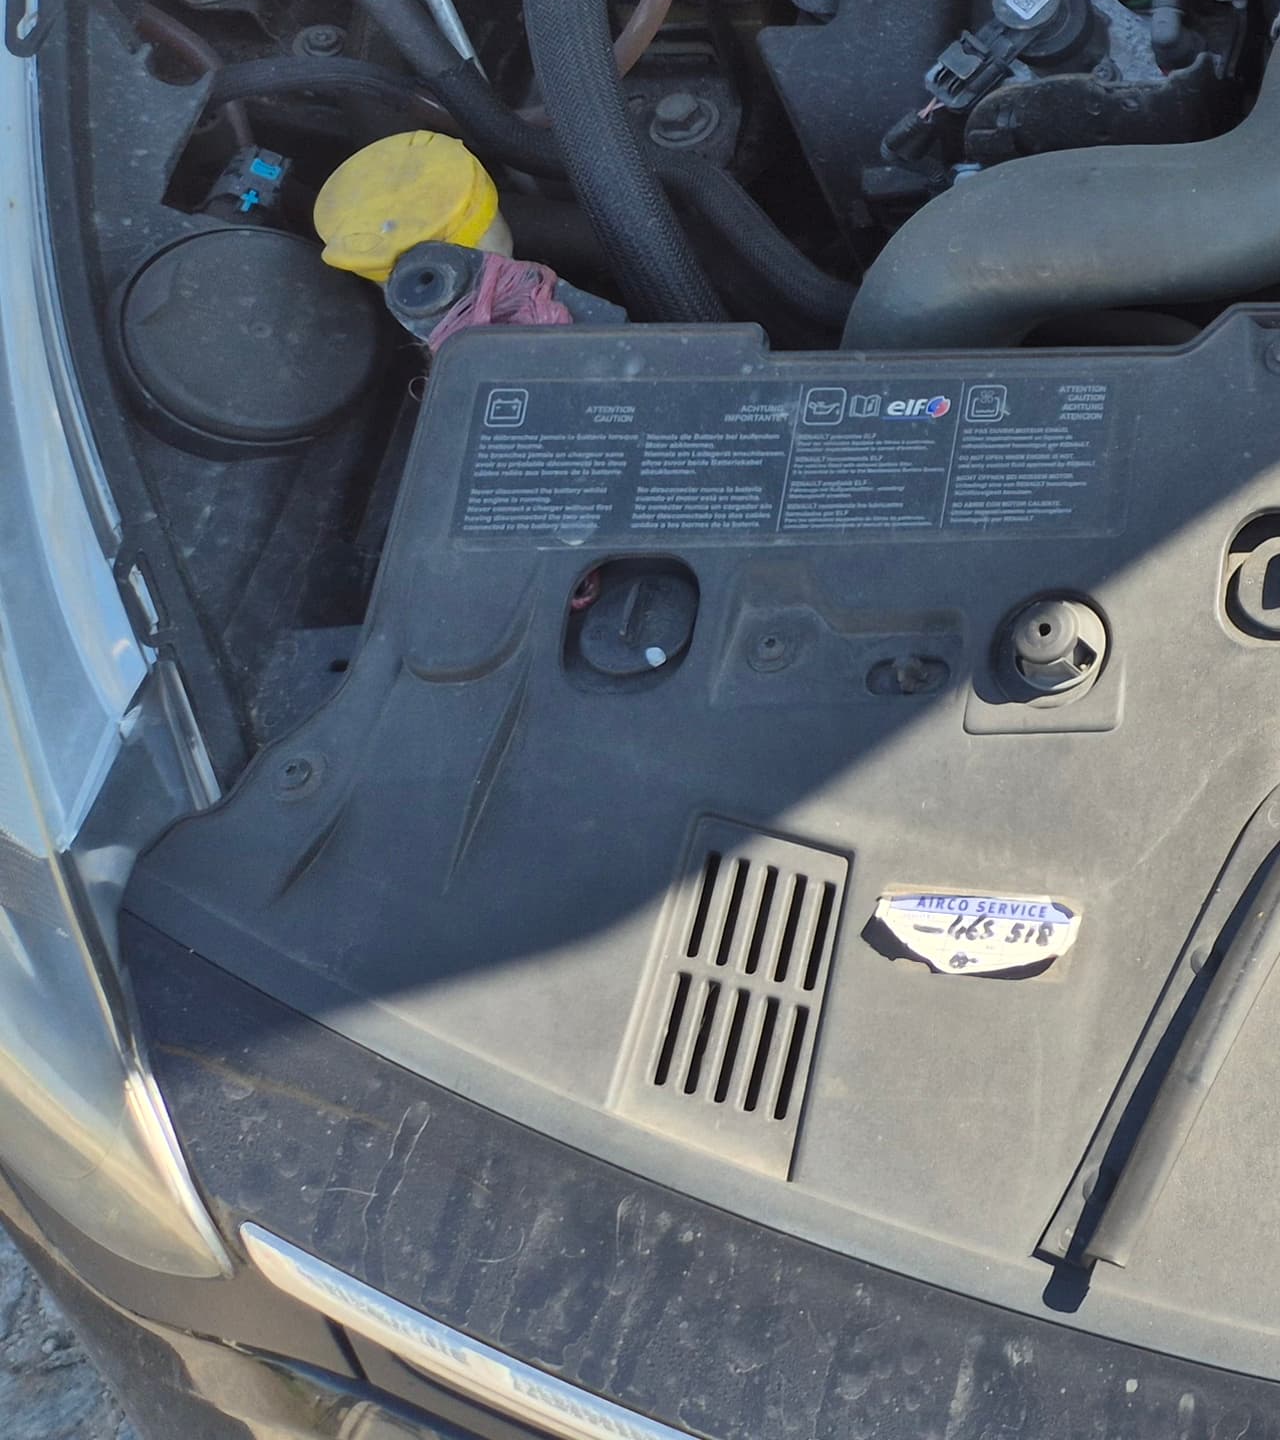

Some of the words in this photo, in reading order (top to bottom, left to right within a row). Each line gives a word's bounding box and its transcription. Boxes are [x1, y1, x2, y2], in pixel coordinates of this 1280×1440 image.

[585, 406, 635, 414] ATTENTION
[740, 405, 784, 413] ACHTUNG
[887, 398, 928, 415] elf
[594, 415, 633, 423] CAUTION
[916, 895, 969, 913] AIRCO
[976, 900, 1049, 919] SERVICE
